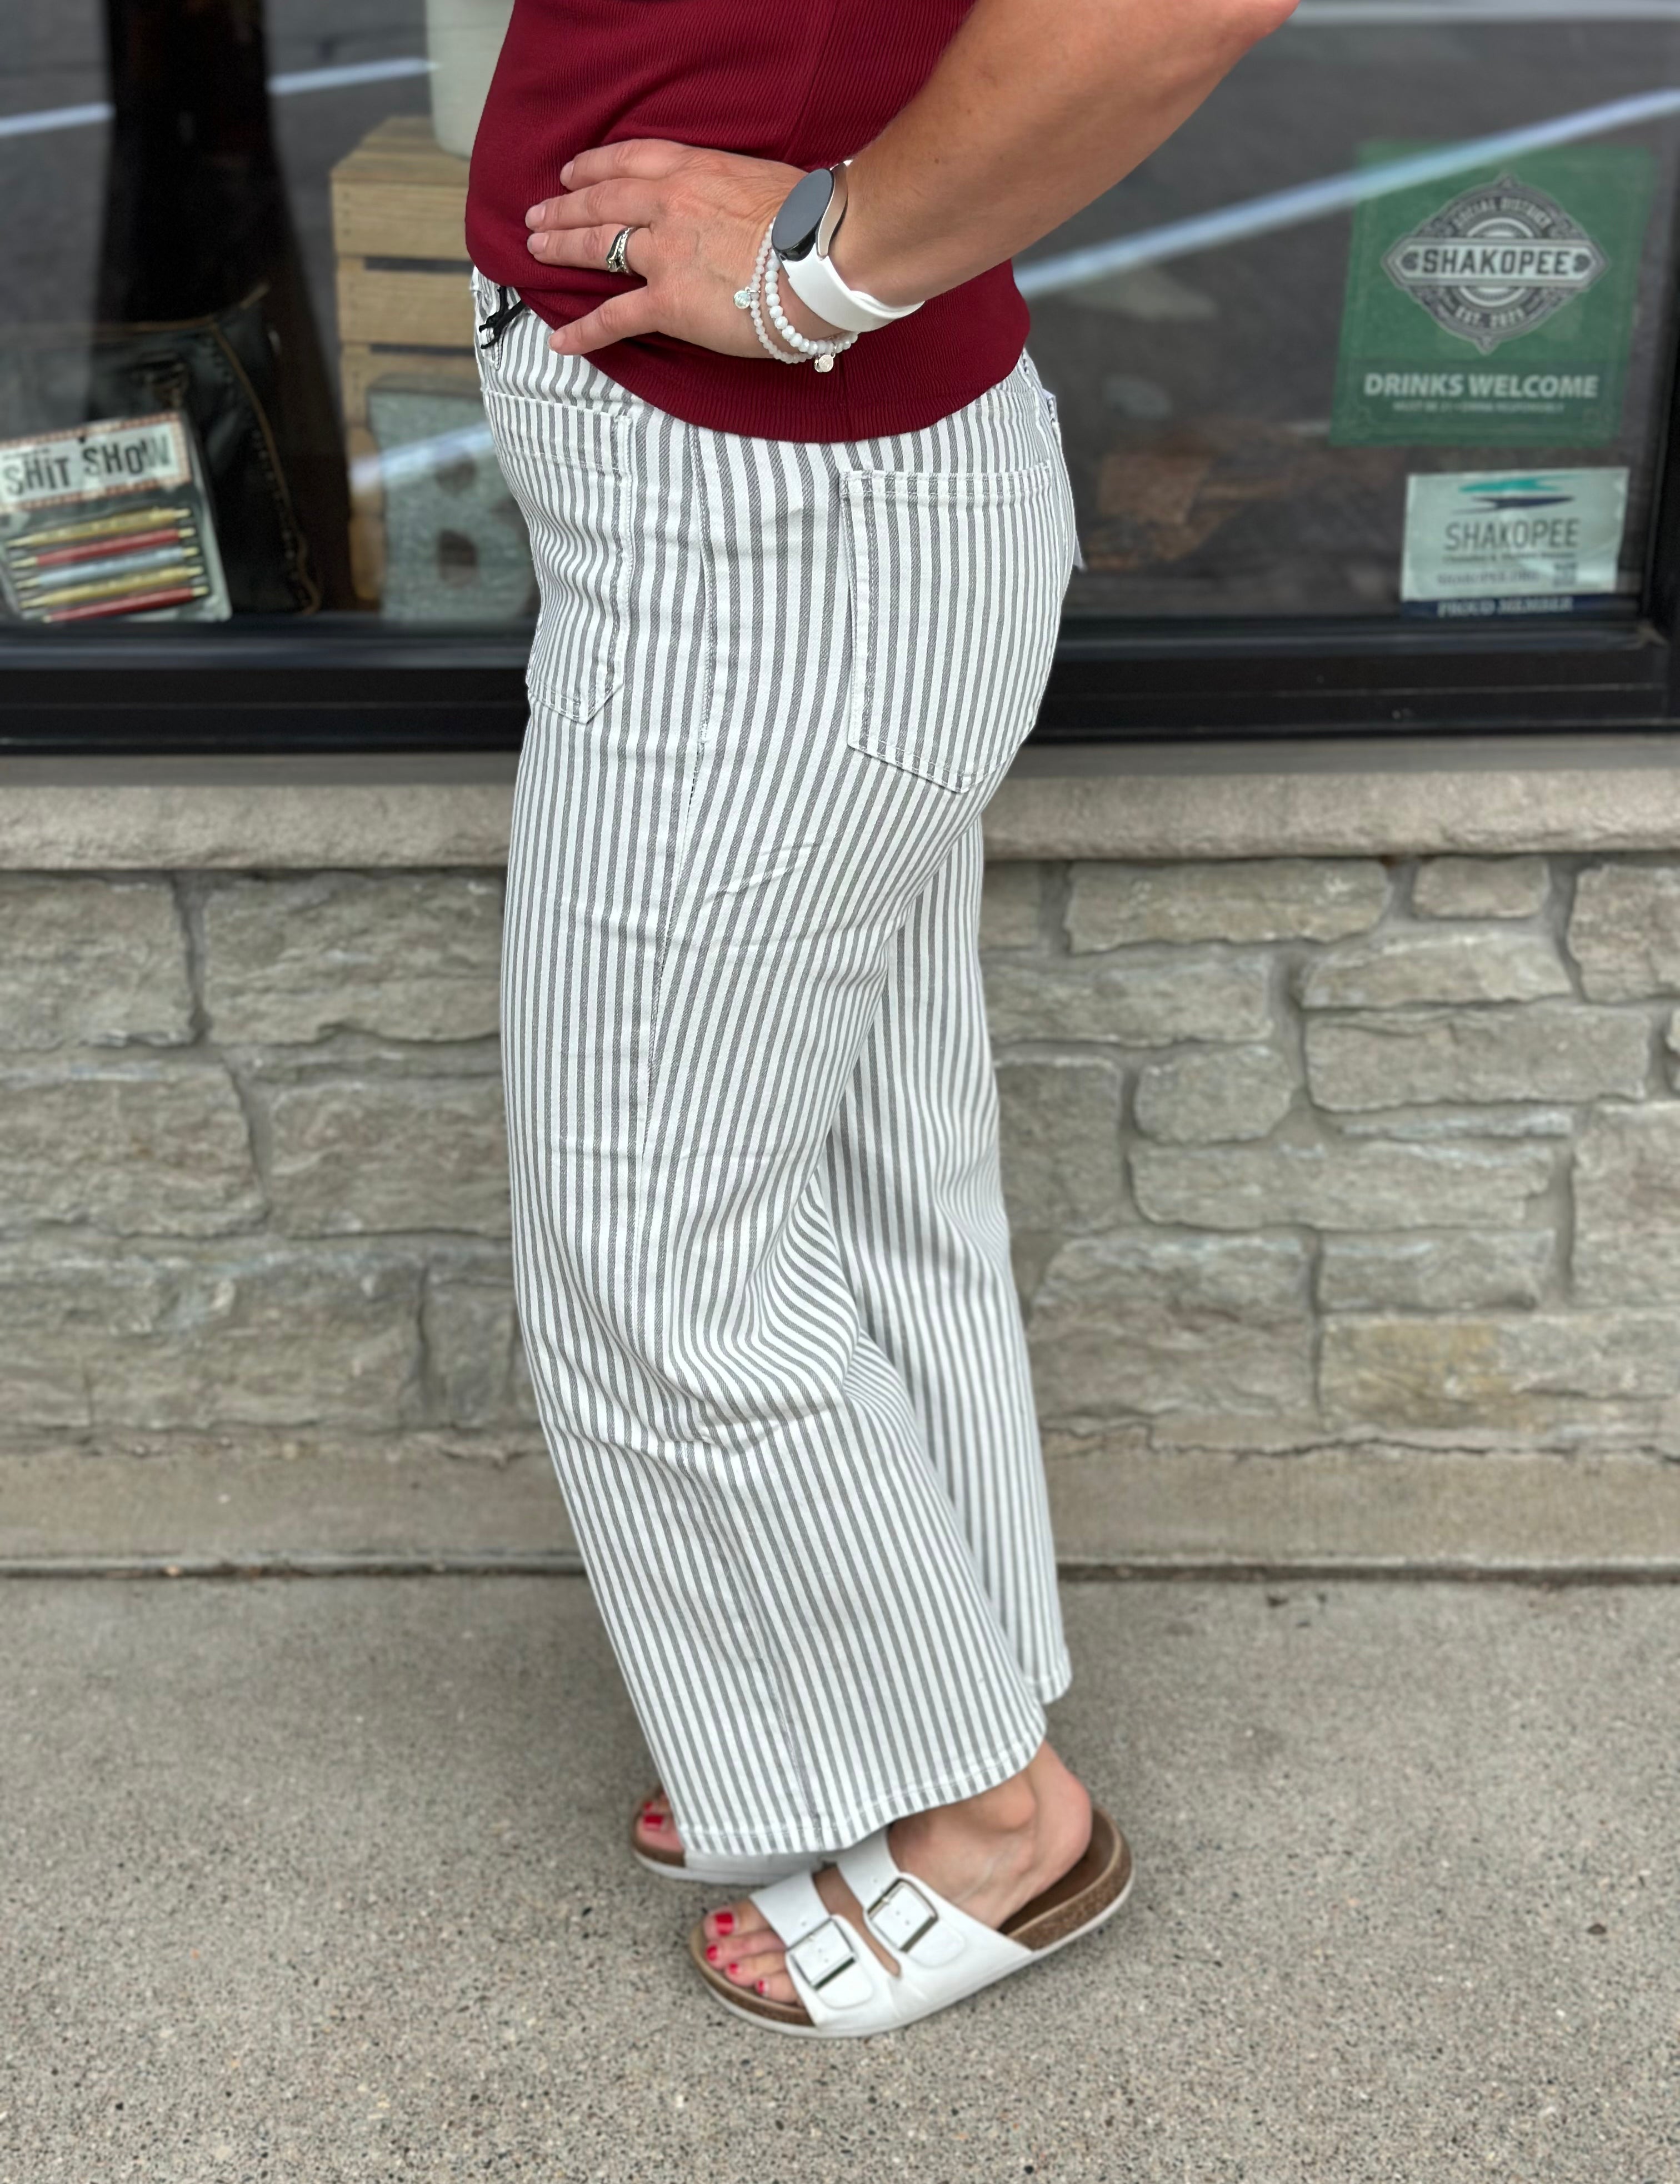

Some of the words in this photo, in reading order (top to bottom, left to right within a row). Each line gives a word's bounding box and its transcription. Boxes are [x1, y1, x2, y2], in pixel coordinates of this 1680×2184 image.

[1422, 248, 1571, 276] SHAKOPEE
[1364, 373, 1464, 397] DRINKS
[1468, 374, 1599, 398] WELCOME
[82, 433, 171, 477] SHOW
[1444, 518, 1581, 551] SHAKOPEE
